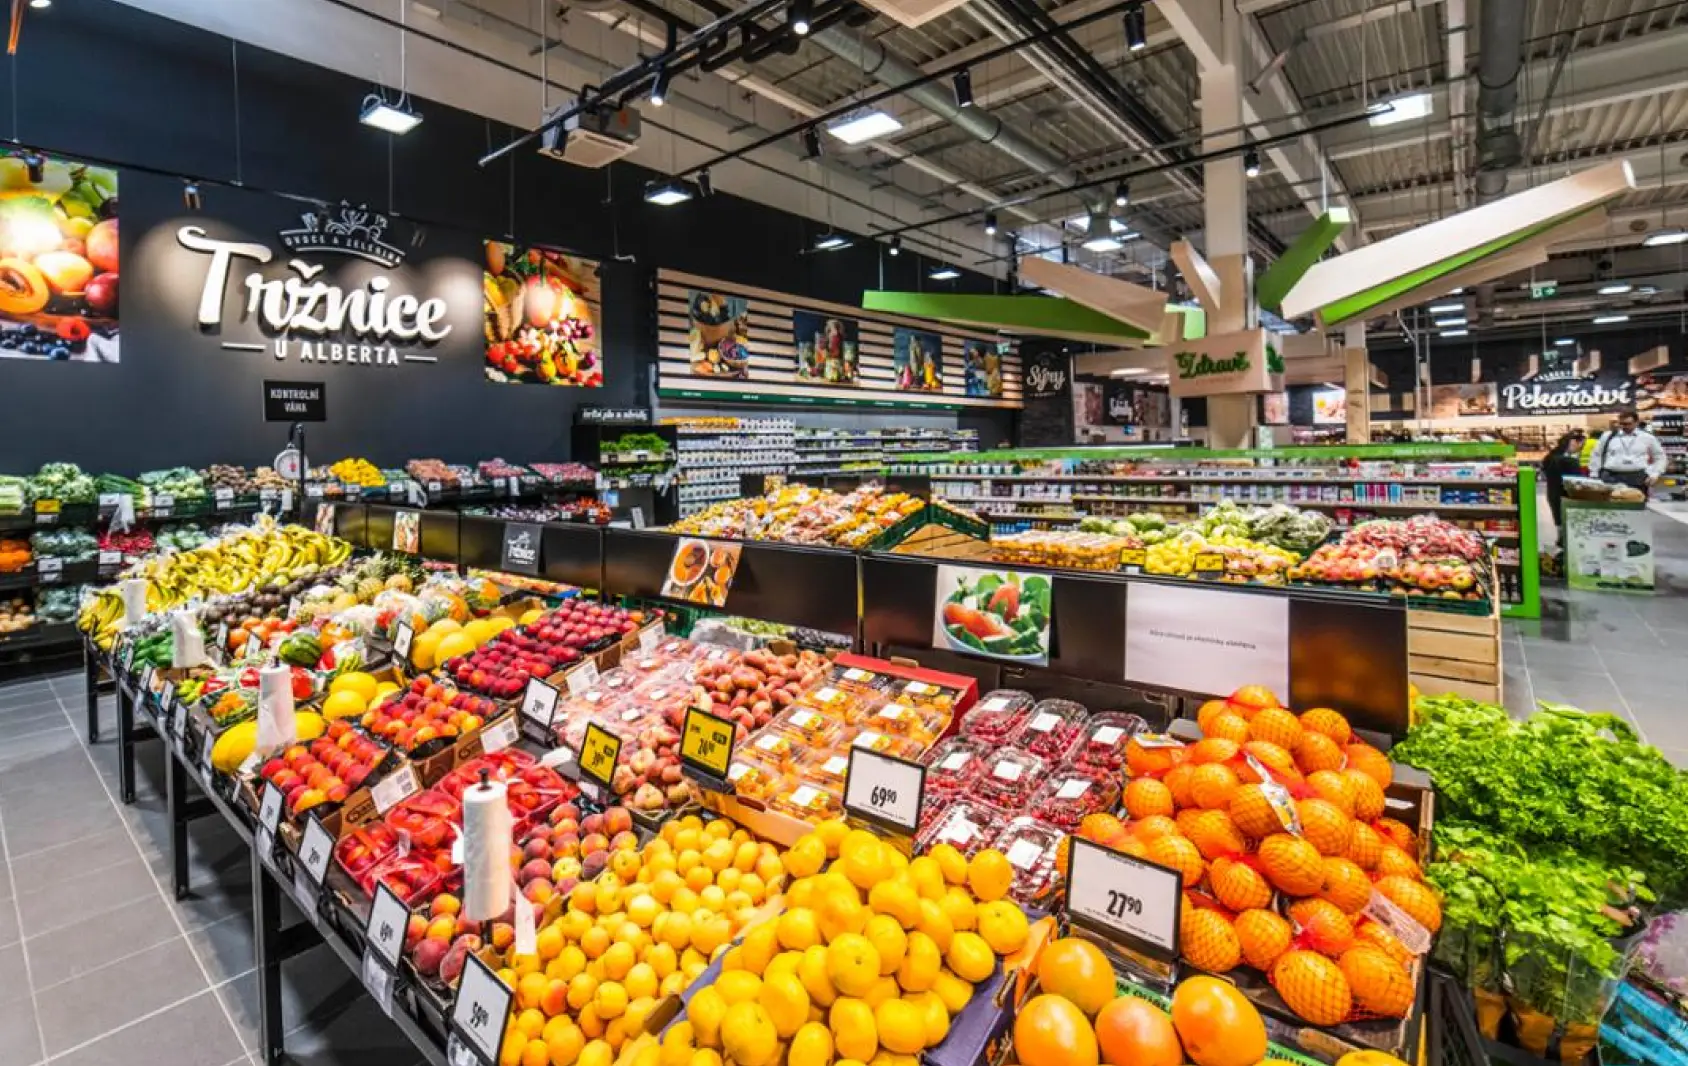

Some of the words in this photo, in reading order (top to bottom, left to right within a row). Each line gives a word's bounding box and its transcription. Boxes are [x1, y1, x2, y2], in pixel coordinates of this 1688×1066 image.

[176, 225, 452, 341] Tržnice
[274, 339, 288, 359] U
[300, 342, 399, 365] ALBERTA
[270, 388, 319, 399] KONTROLNÍ
[1502, 381, 1632, 409] Pekařství
